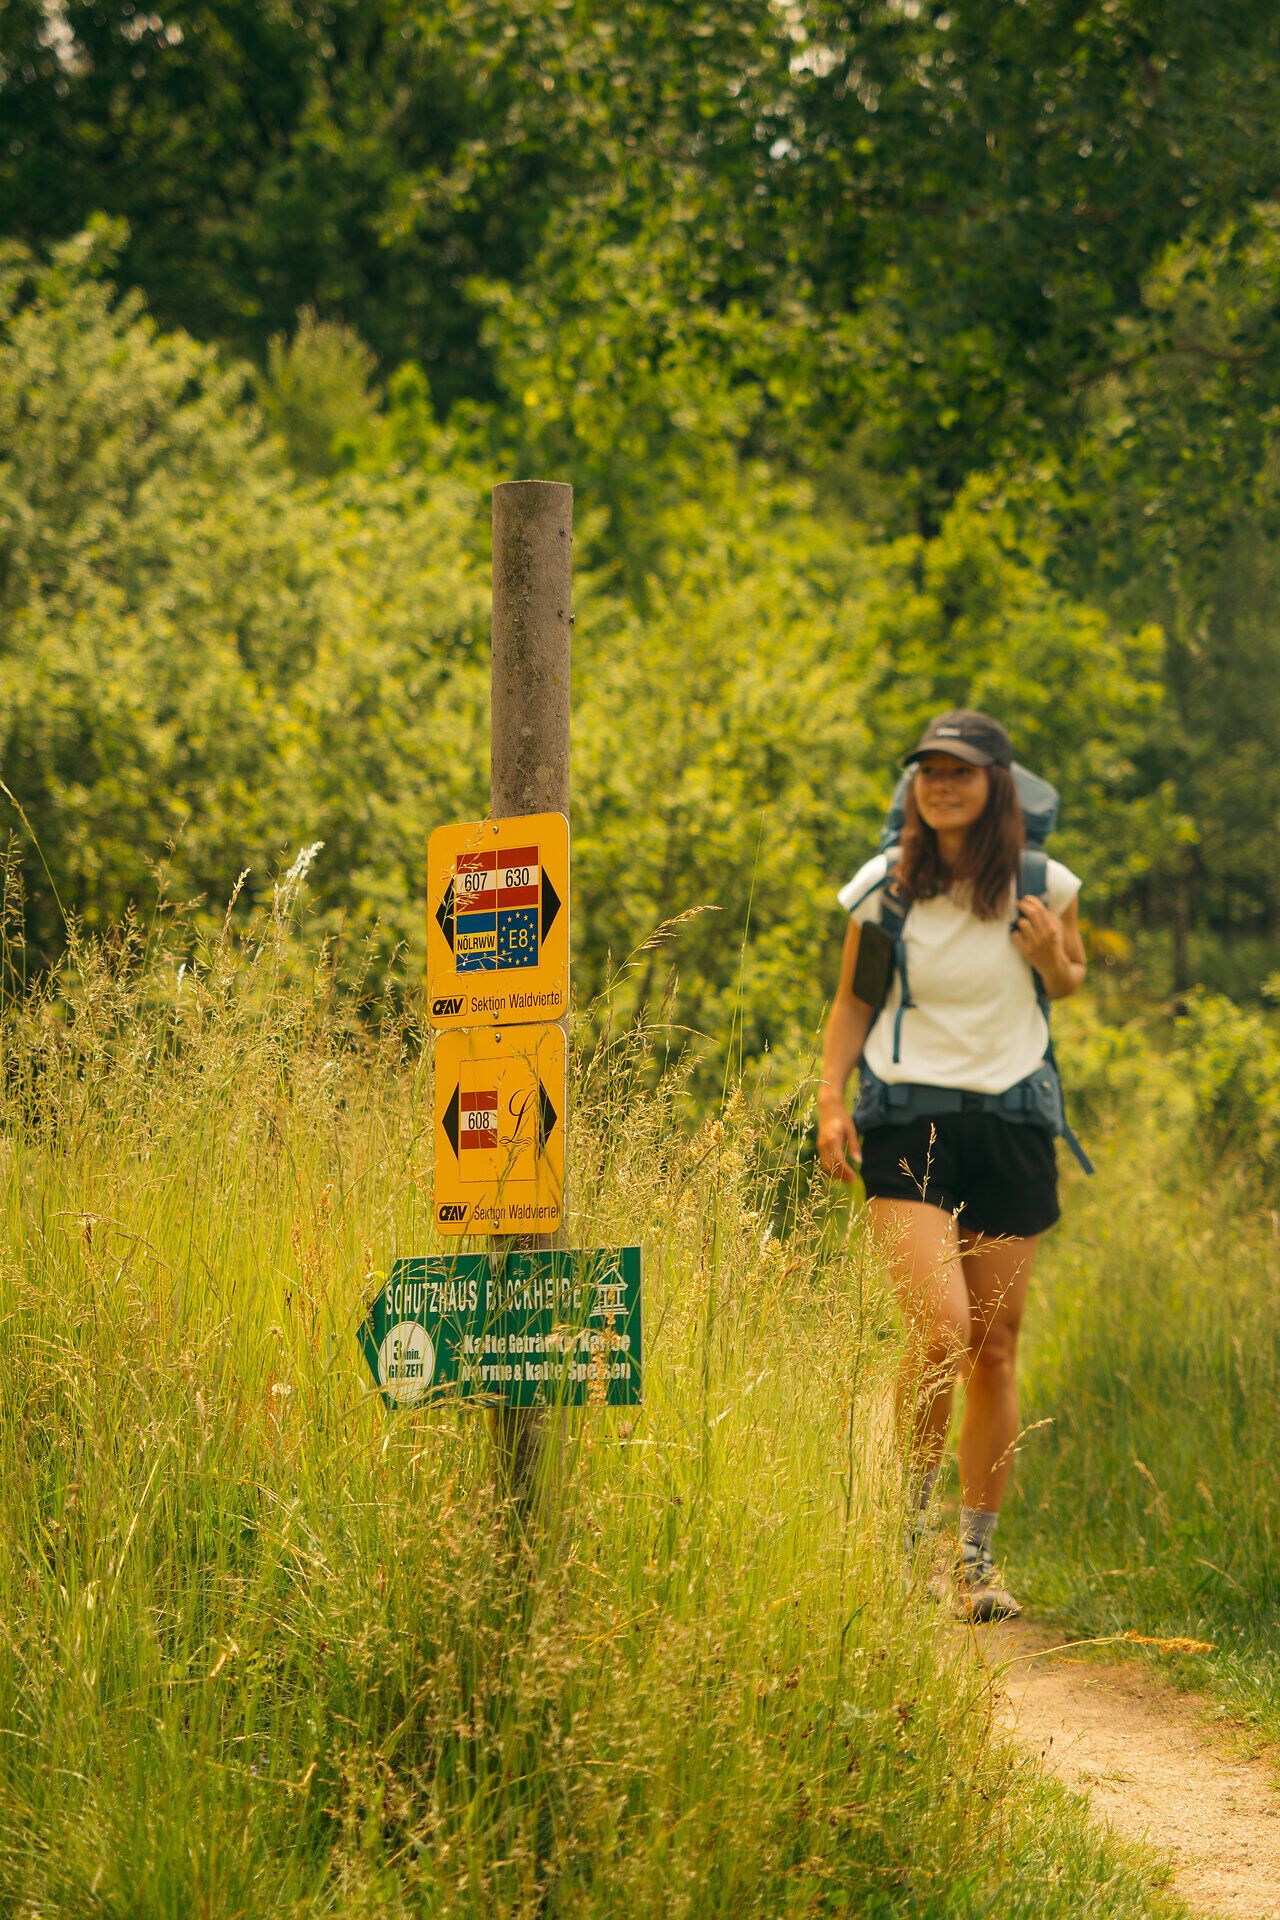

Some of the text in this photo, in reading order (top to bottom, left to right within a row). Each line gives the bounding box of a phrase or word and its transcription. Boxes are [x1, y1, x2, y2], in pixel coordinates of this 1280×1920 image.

[465, 873, 488, 892] 607
[505, 868, 530, 888] 630
[457, 935, 496, 951] NÖLRWW
[509, 928, 529, 949] E8
[471, 990, 563, 1012] Sektion Waldviertel
[468, 1111, 490, 1130] 608
[473, 1205, 506, 1221] Sektion
[386, 1280, 478, 1315] SCHUTZHAUS
[463, 1334, 506, 1354] Kalte
[388, 1363, 424, 1378] GZEIT
[459, 1364, 512, 1381] Wrme
[567, 1360, 631, 1382] Spesen
